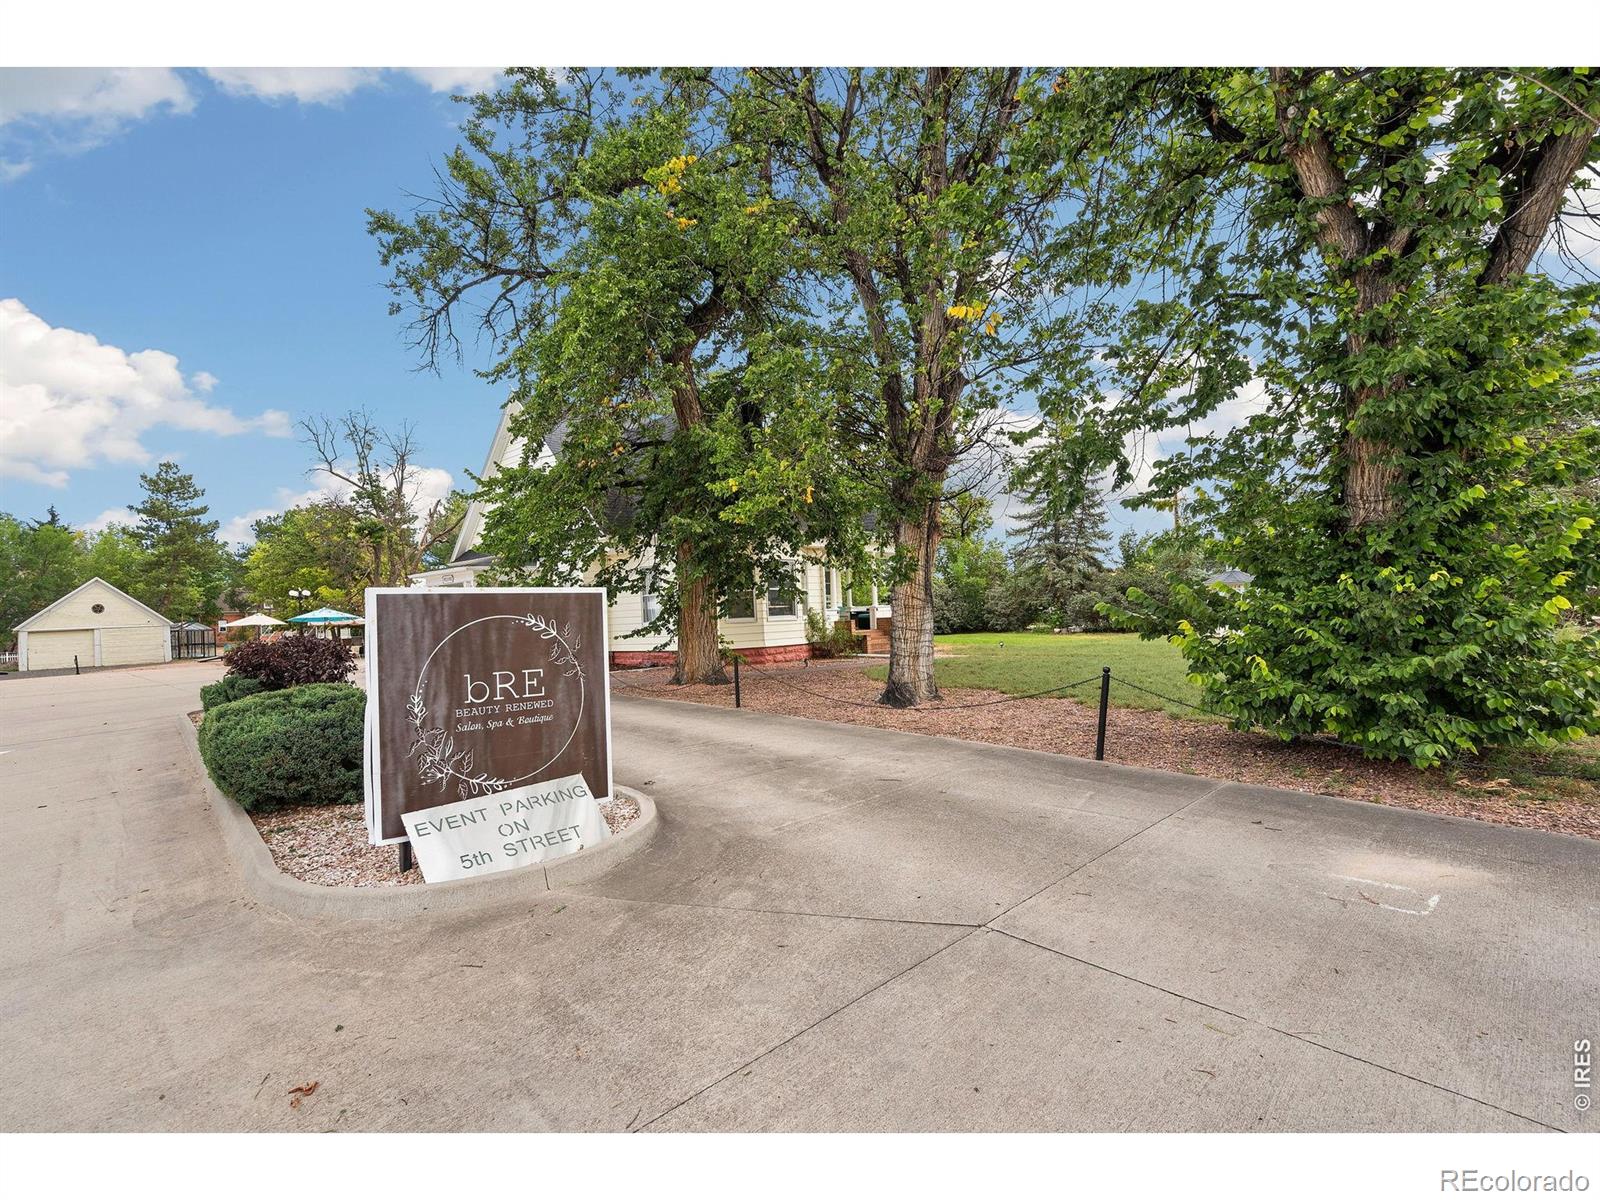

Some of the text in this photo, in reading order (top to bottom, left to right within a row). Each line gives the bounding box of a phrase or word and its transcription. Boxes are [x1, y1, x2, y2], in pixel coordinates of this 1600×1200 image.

[463, 668, 546, 704] bRE
[455, 699, 554, 718] BEAUTY RENEWED
[455, 713, 554, 733] Salon, Spa & Boutique
[413, 785, 588, 838] EVENT PARKING
[497, 818, 530, 837] ON
[459, 824, 583, 870] 5th STREET
